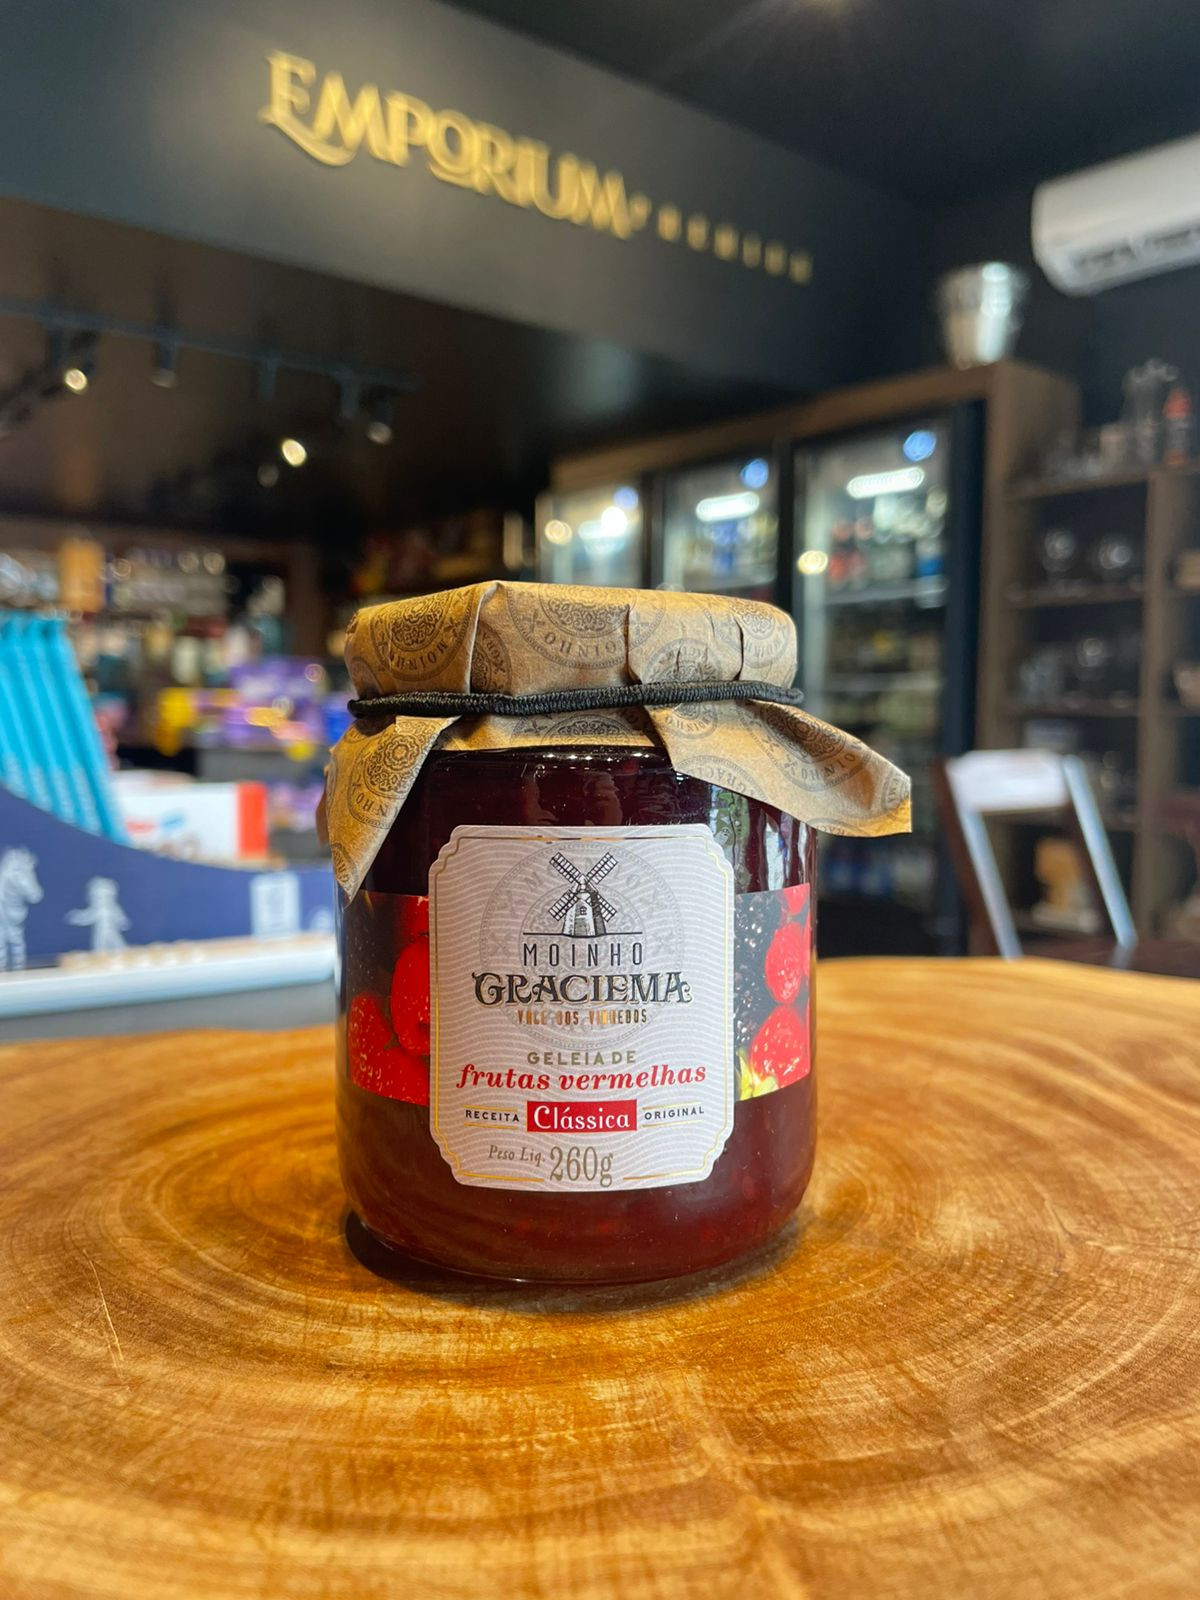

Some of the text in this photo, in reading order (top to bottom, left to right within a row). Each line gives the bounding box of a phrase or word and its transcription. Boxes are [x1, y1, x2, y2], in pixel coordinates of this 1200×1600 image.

[258, 51, 634, 240] EMPORIUM
[522, 942, 643, 968] MOINHO
[471, 970, 694, 1006] GRACIEMA
[554, 1010, 580, 1026] DOS
[526, 1050, 637, 1066] GELEIA DE
[456, 1064, 707, 1091] frutas vermelhas
[465, 1104, 706, 1131] RECEITA Clássica ORIGINAL
[488, 1144, 516, 1161] Peso
[549, 1145, 614, 1188] 260g
